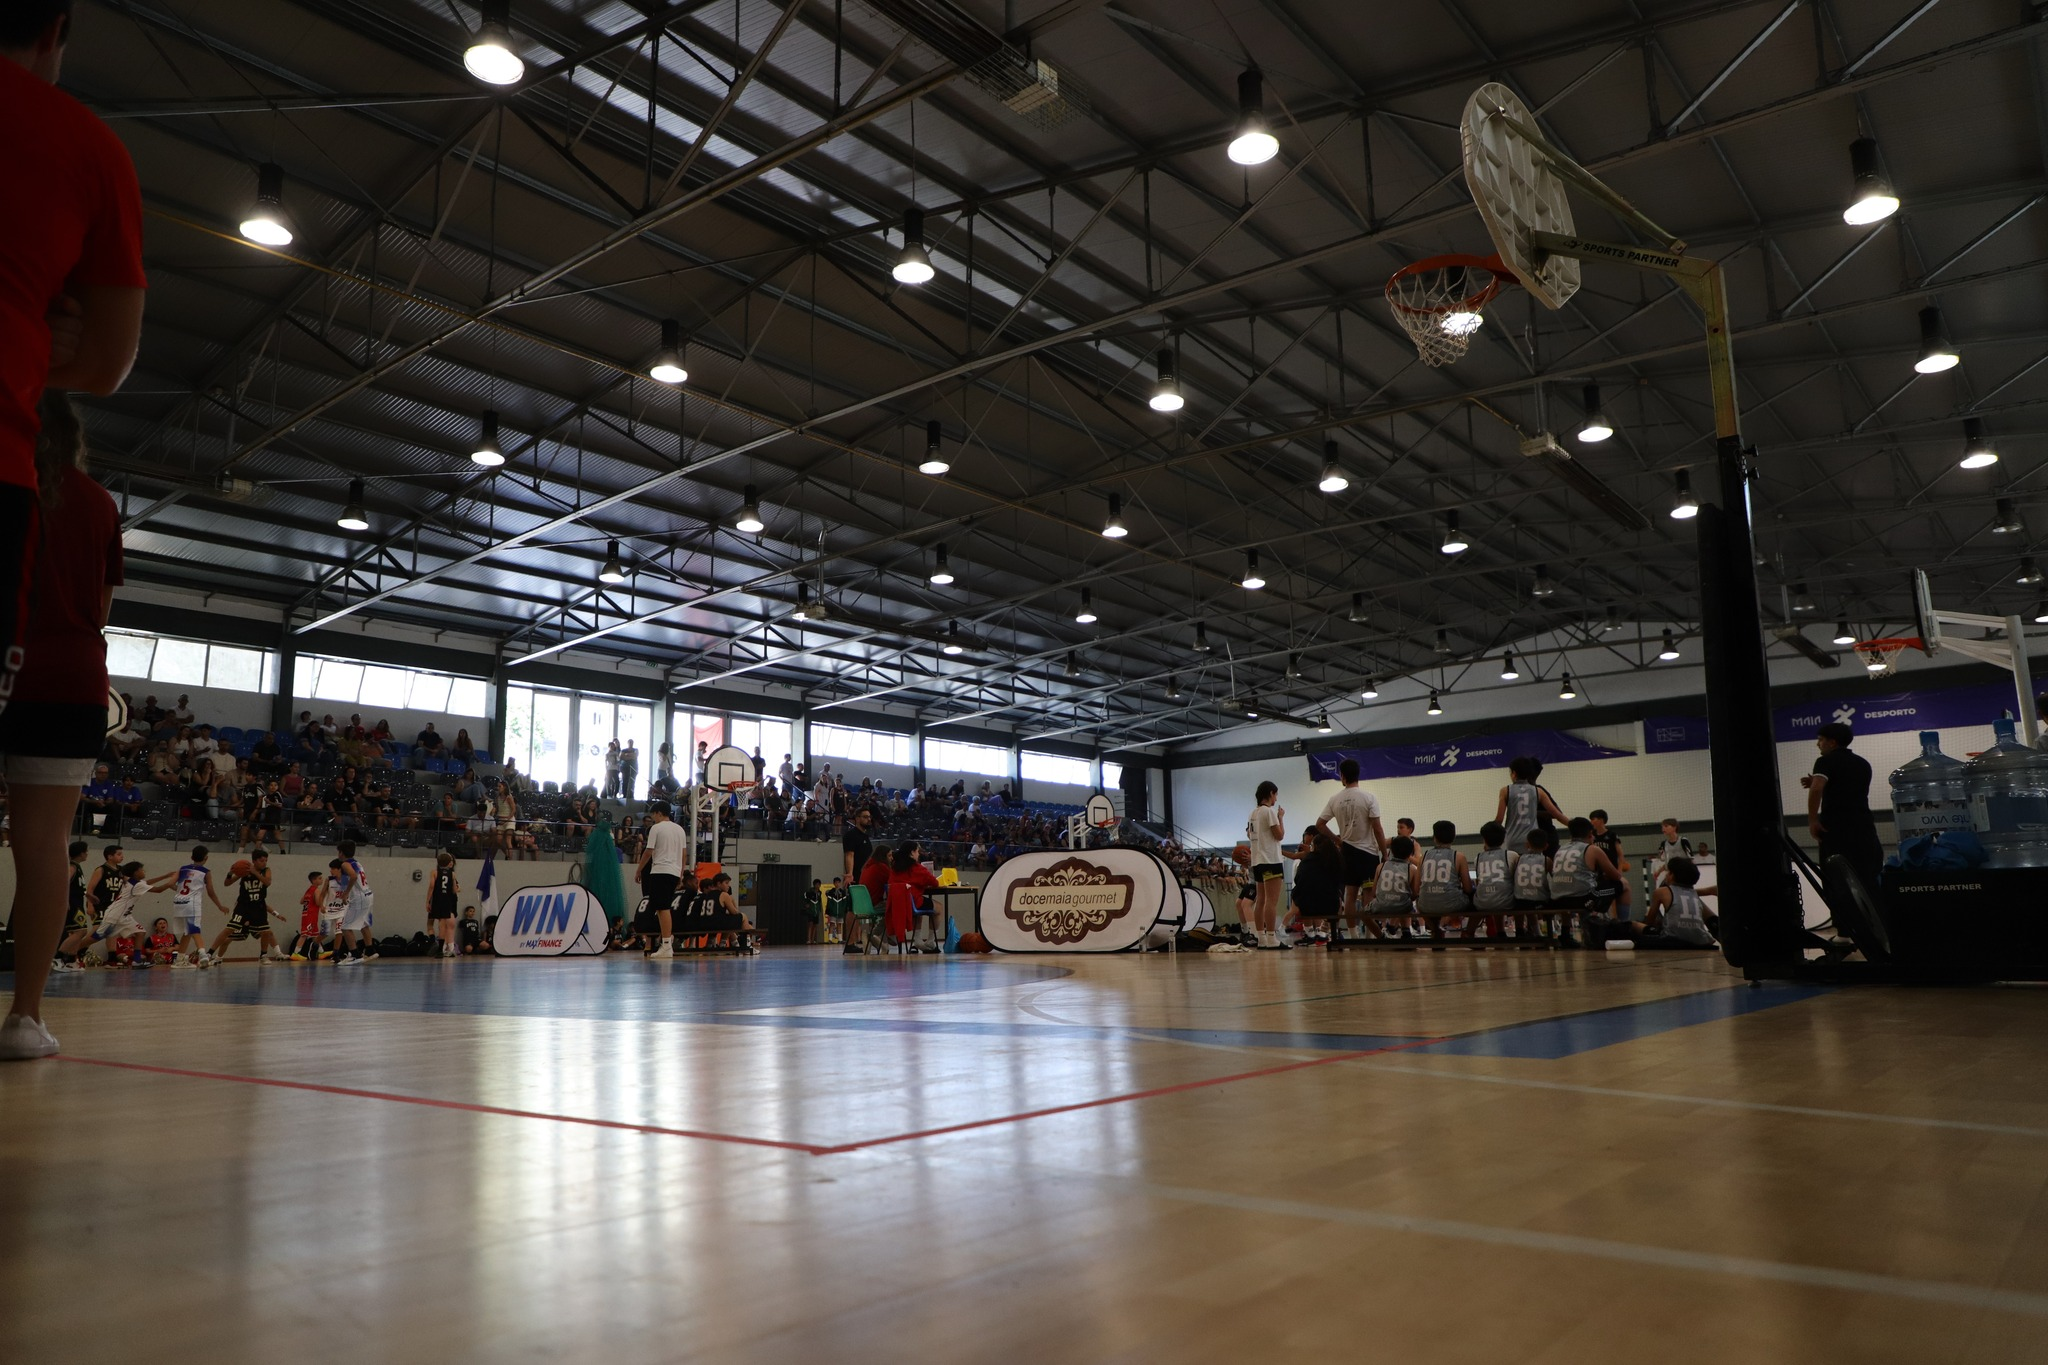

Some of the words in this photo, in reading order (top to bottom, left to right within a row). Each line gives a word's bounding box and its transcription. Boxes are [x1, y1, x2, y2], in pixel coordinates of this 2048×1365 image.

[1583, 242, 1625, 258] SPORTS
[1627, 250, 1680, 268] PARTNER
[1864, 707, 1917, 719] DESPORTO
[1465, 748, 1503, 758] DESPORTO
[180, 879, 192, 896] 5
[441, 876, 449, 889] 2
[1899, 885, 1935, 893] SPORTS
[1937, 883, 1982, 892] PARTNER
[511, 892, 576, 935] WIN
